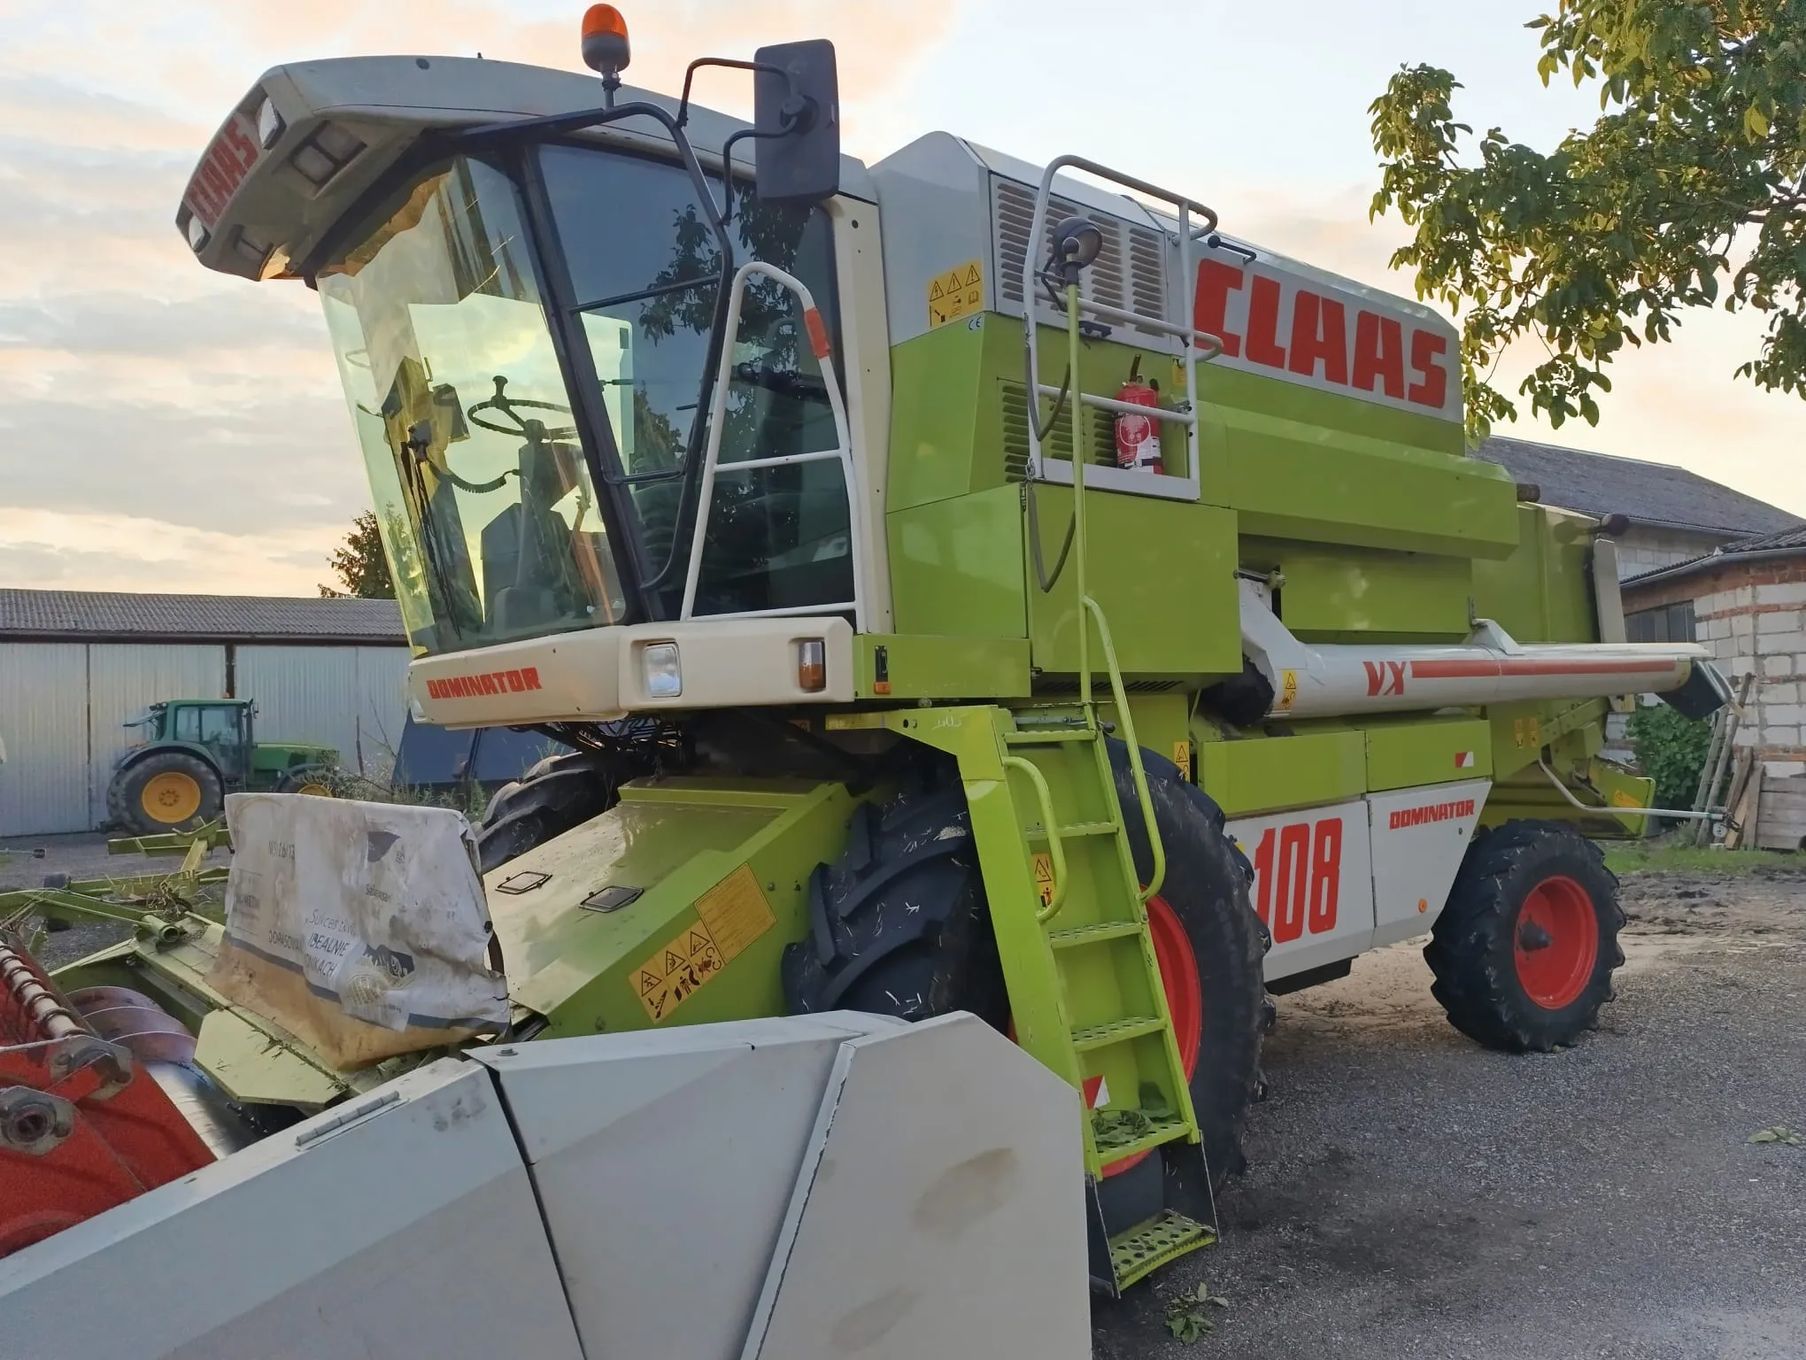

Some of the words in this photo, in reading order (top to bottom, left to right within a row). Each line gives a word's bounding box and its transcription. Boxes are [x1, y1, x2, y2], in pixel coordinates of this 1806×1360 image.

[187, 116, 259, 228] CLAAS
[1194, 258, 1447, 409] CLAAS
[426, 667, 542, 699] DOMINATOR
[1363, 661, 1407, 696] VX
[1389, 799, 1475, 830] DOMINATOR
[1254, 817, 1342, 944] 108
